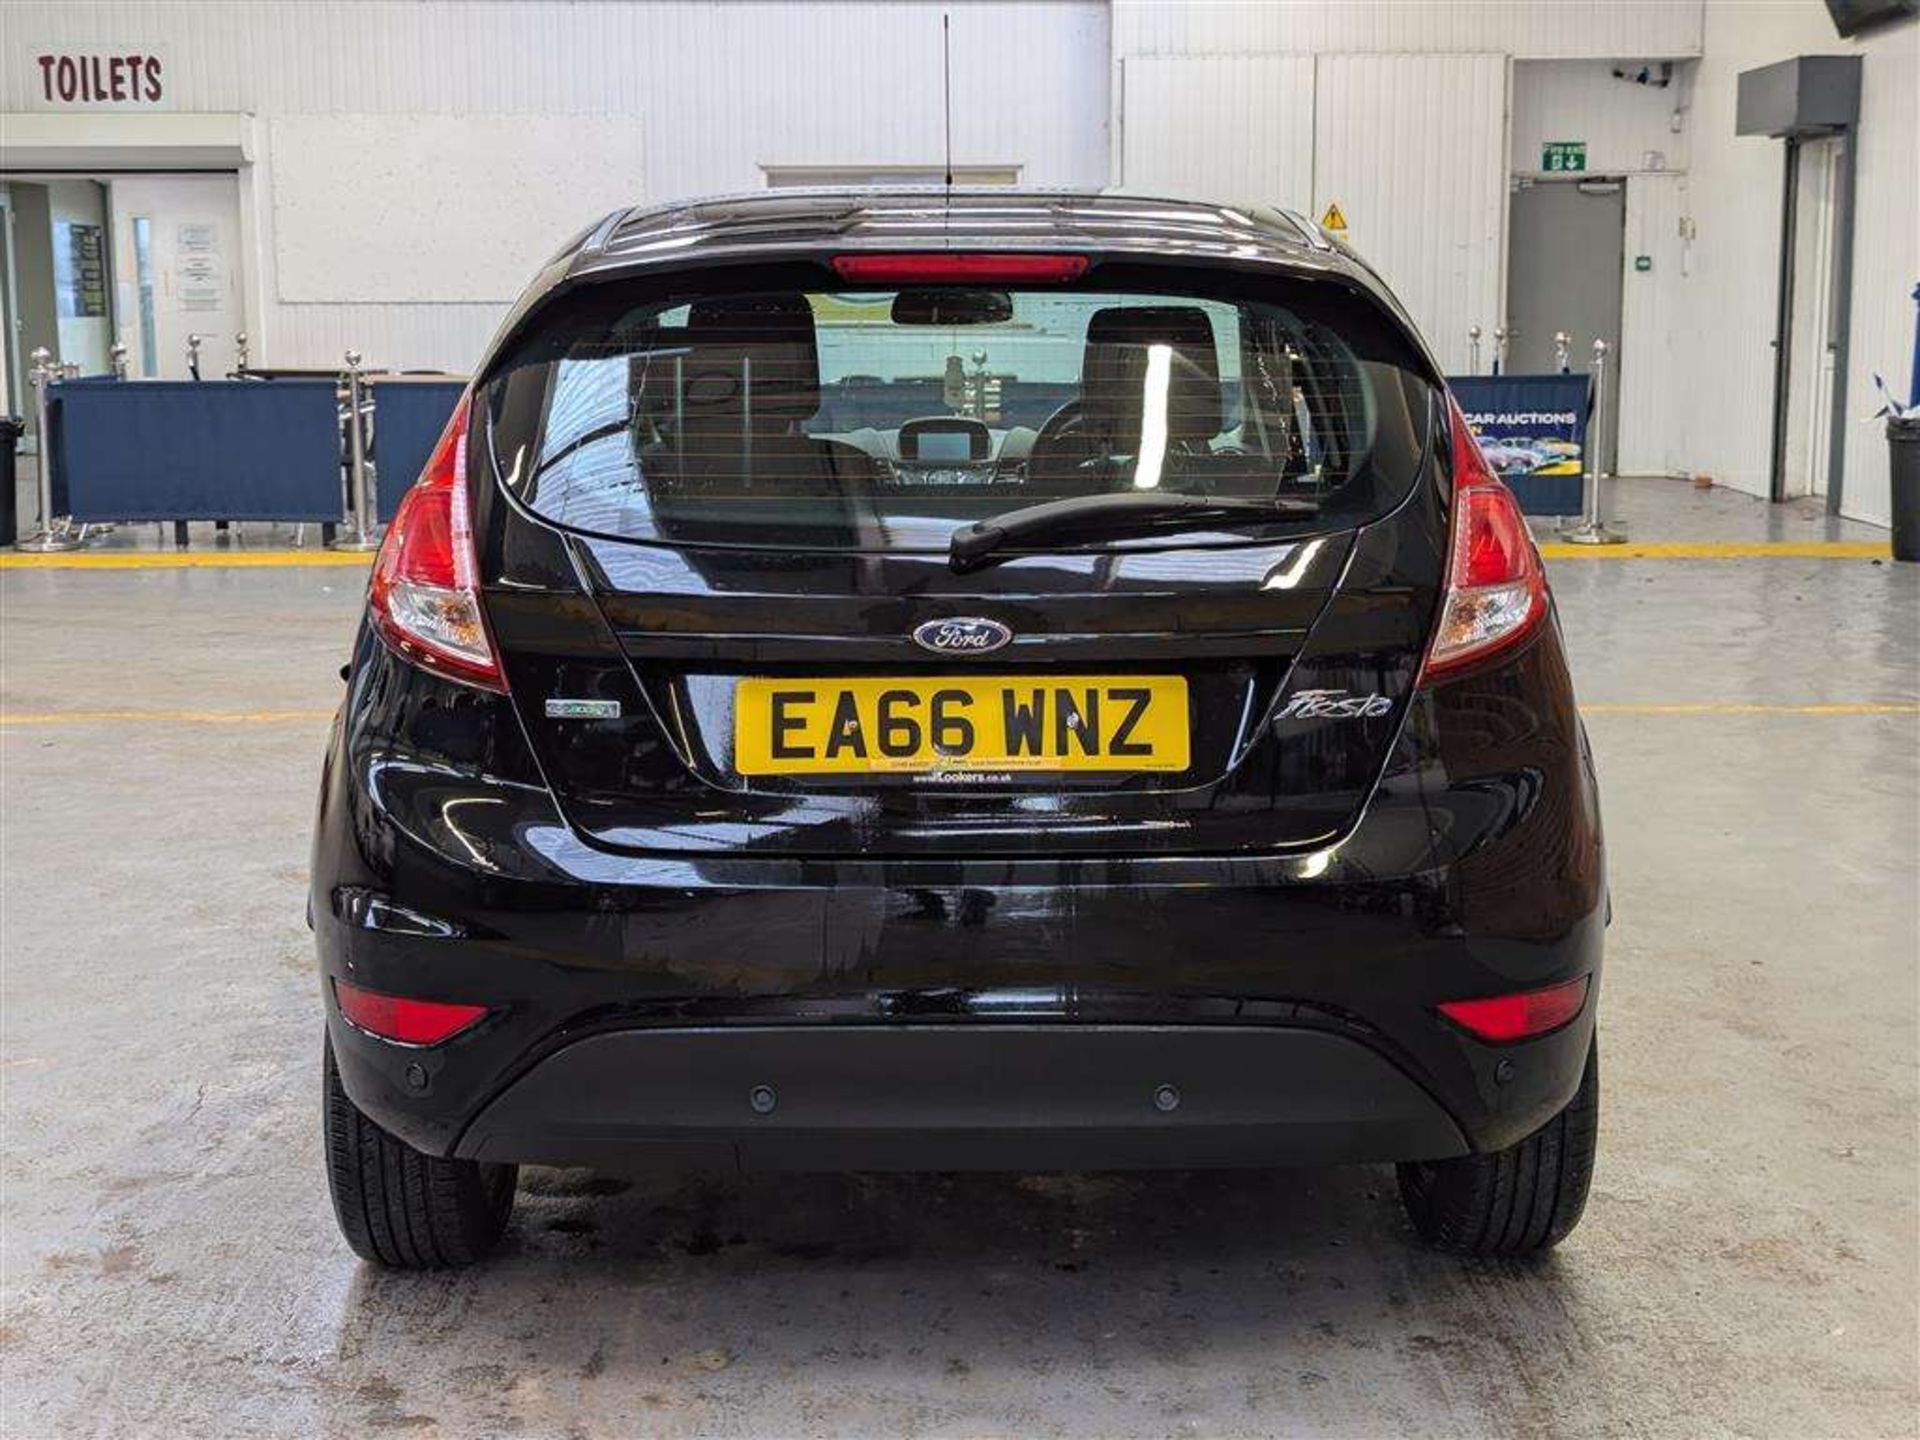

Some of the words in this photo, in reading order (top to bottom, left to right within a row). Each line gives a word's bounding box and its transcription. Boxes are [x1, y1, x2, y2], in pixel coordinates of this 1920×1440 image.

[38, 55, 161, 101] TOILETS
[1497, 412, 1577, 424] AUCTIONS
[935, 623, 989, 647] Ford
[1273, 689, 1392, 720] Fiesta
[770, 690, 974, 759] EA66
[1002, 688, 1153, 757] WNZ
